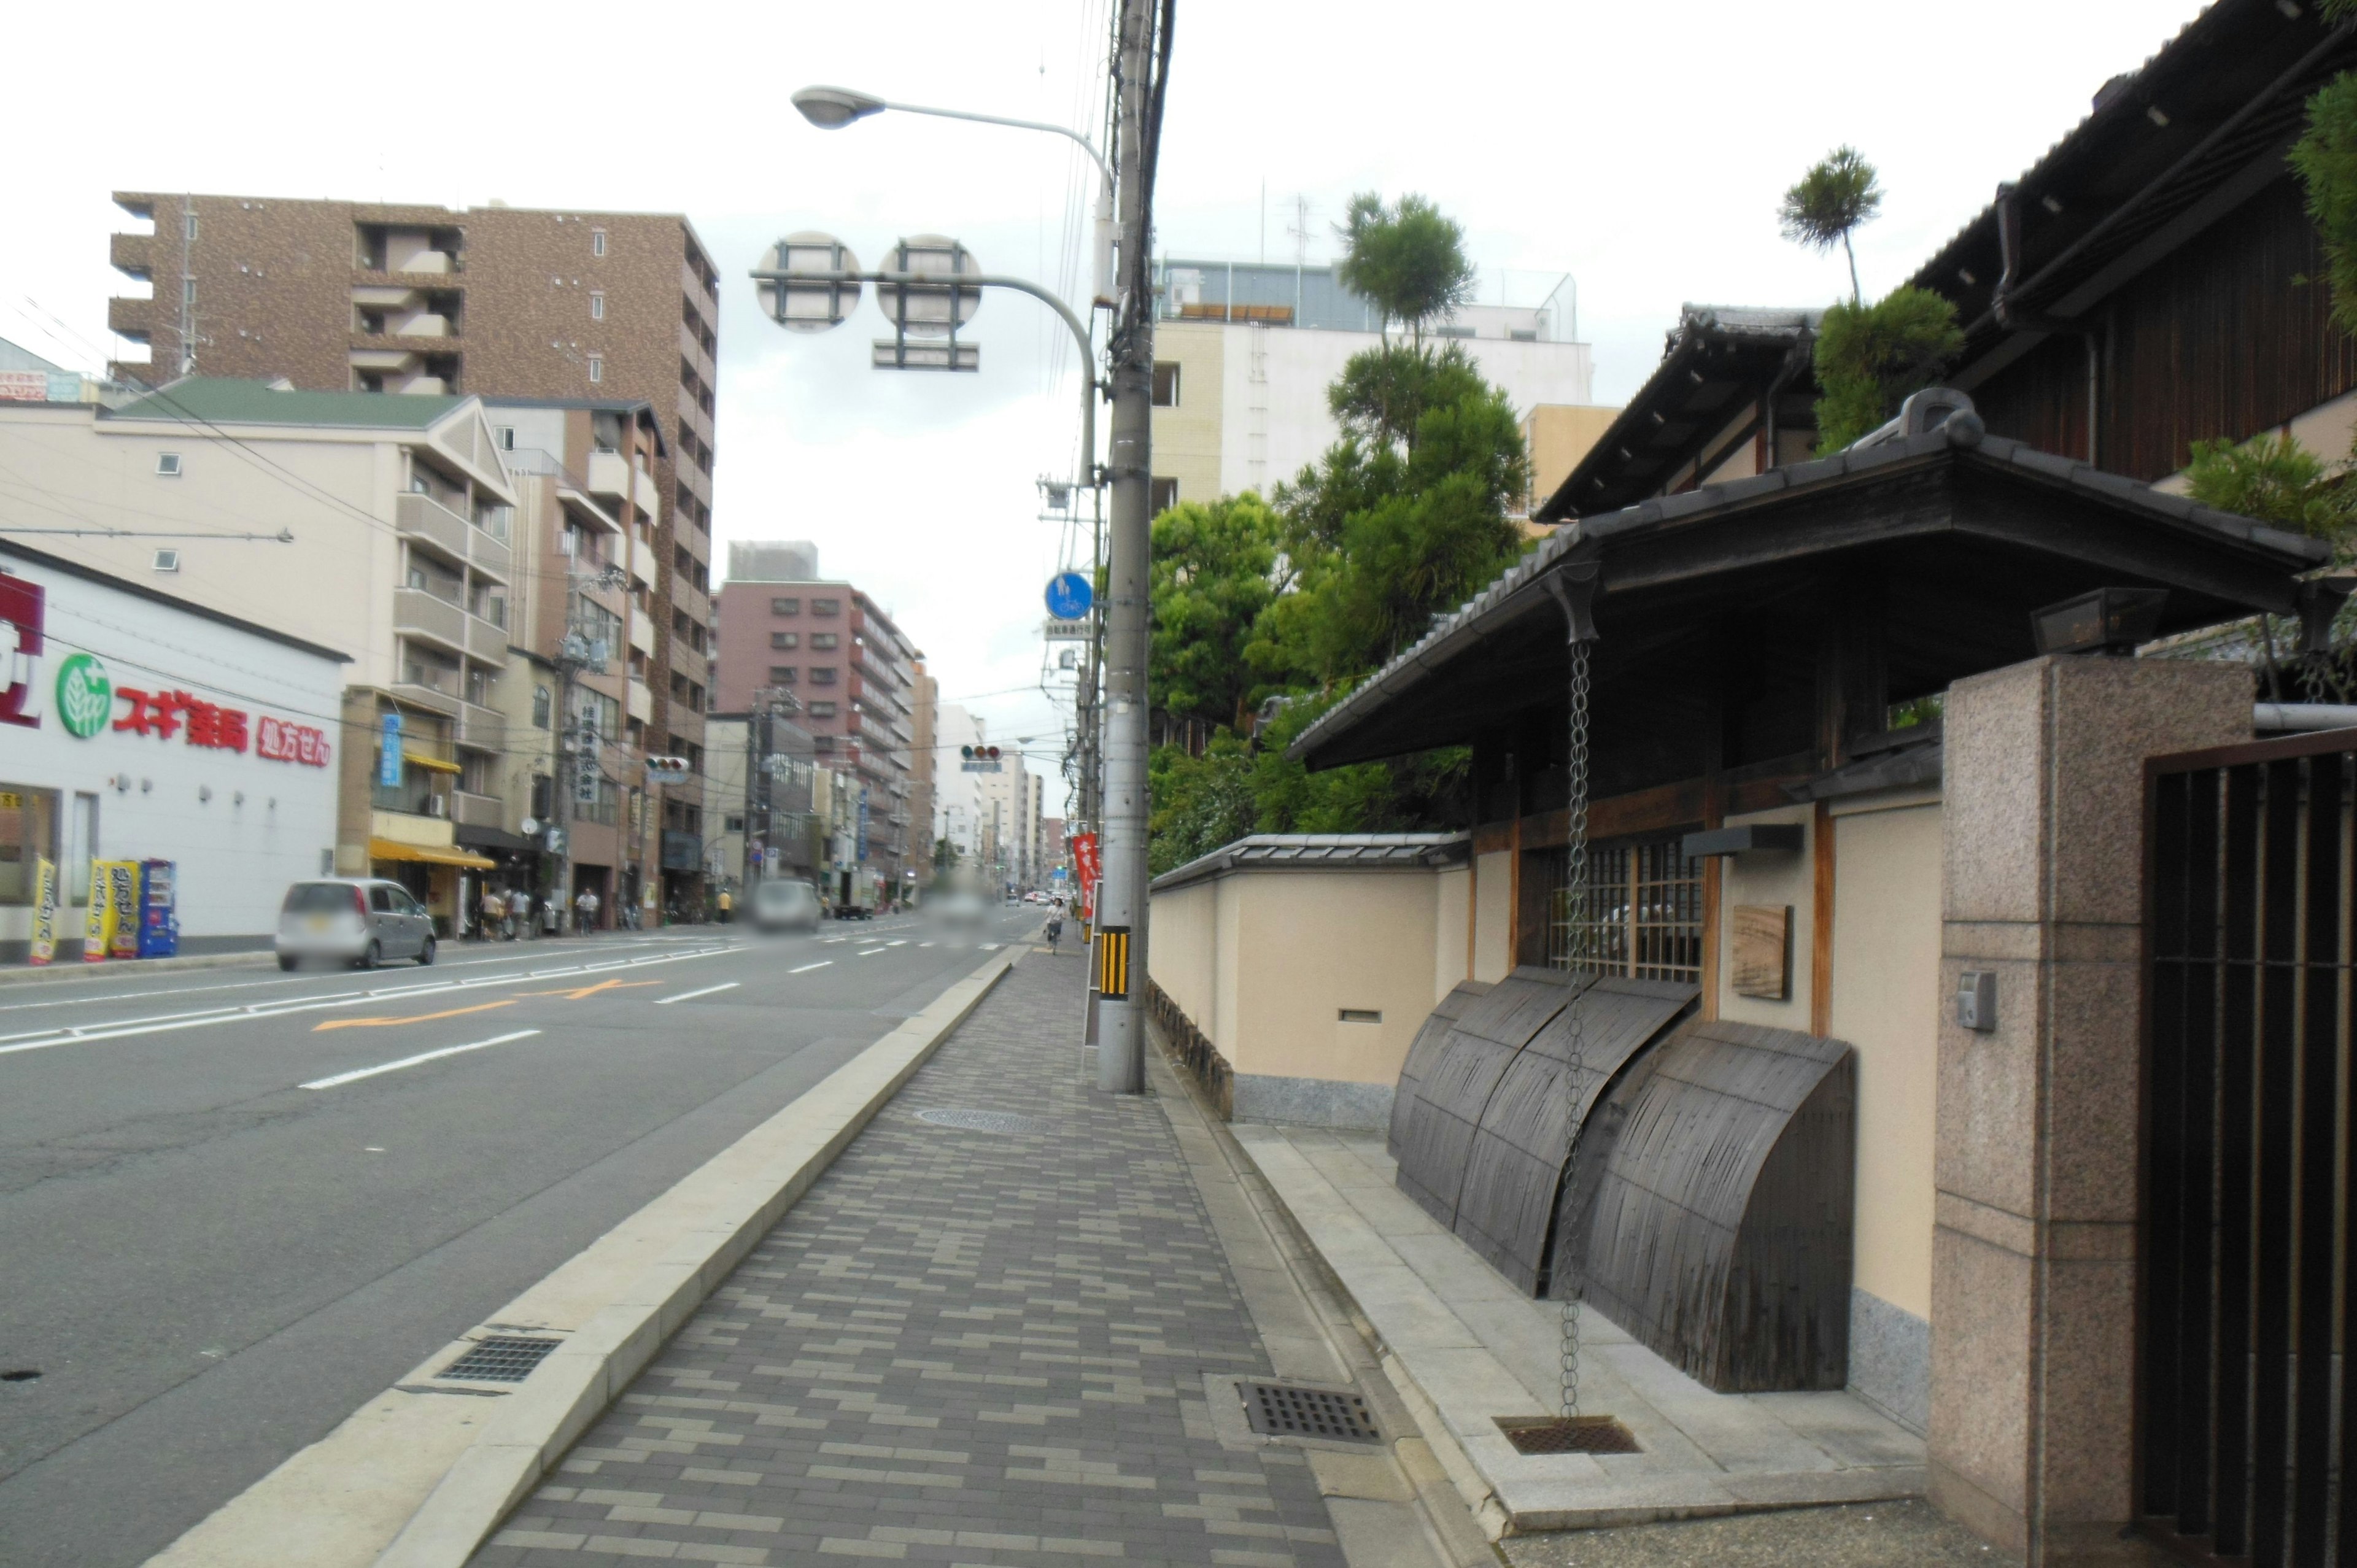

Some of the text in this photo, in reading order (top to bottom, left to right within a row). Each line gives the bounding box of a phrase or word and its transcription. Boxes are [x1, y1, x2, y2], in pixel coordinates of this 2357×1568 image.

[113, 687, 248, 753] スギ薬局
[260, 716, 330, 767] 処方せん
[110, 867, 133, 933] 処方せん
